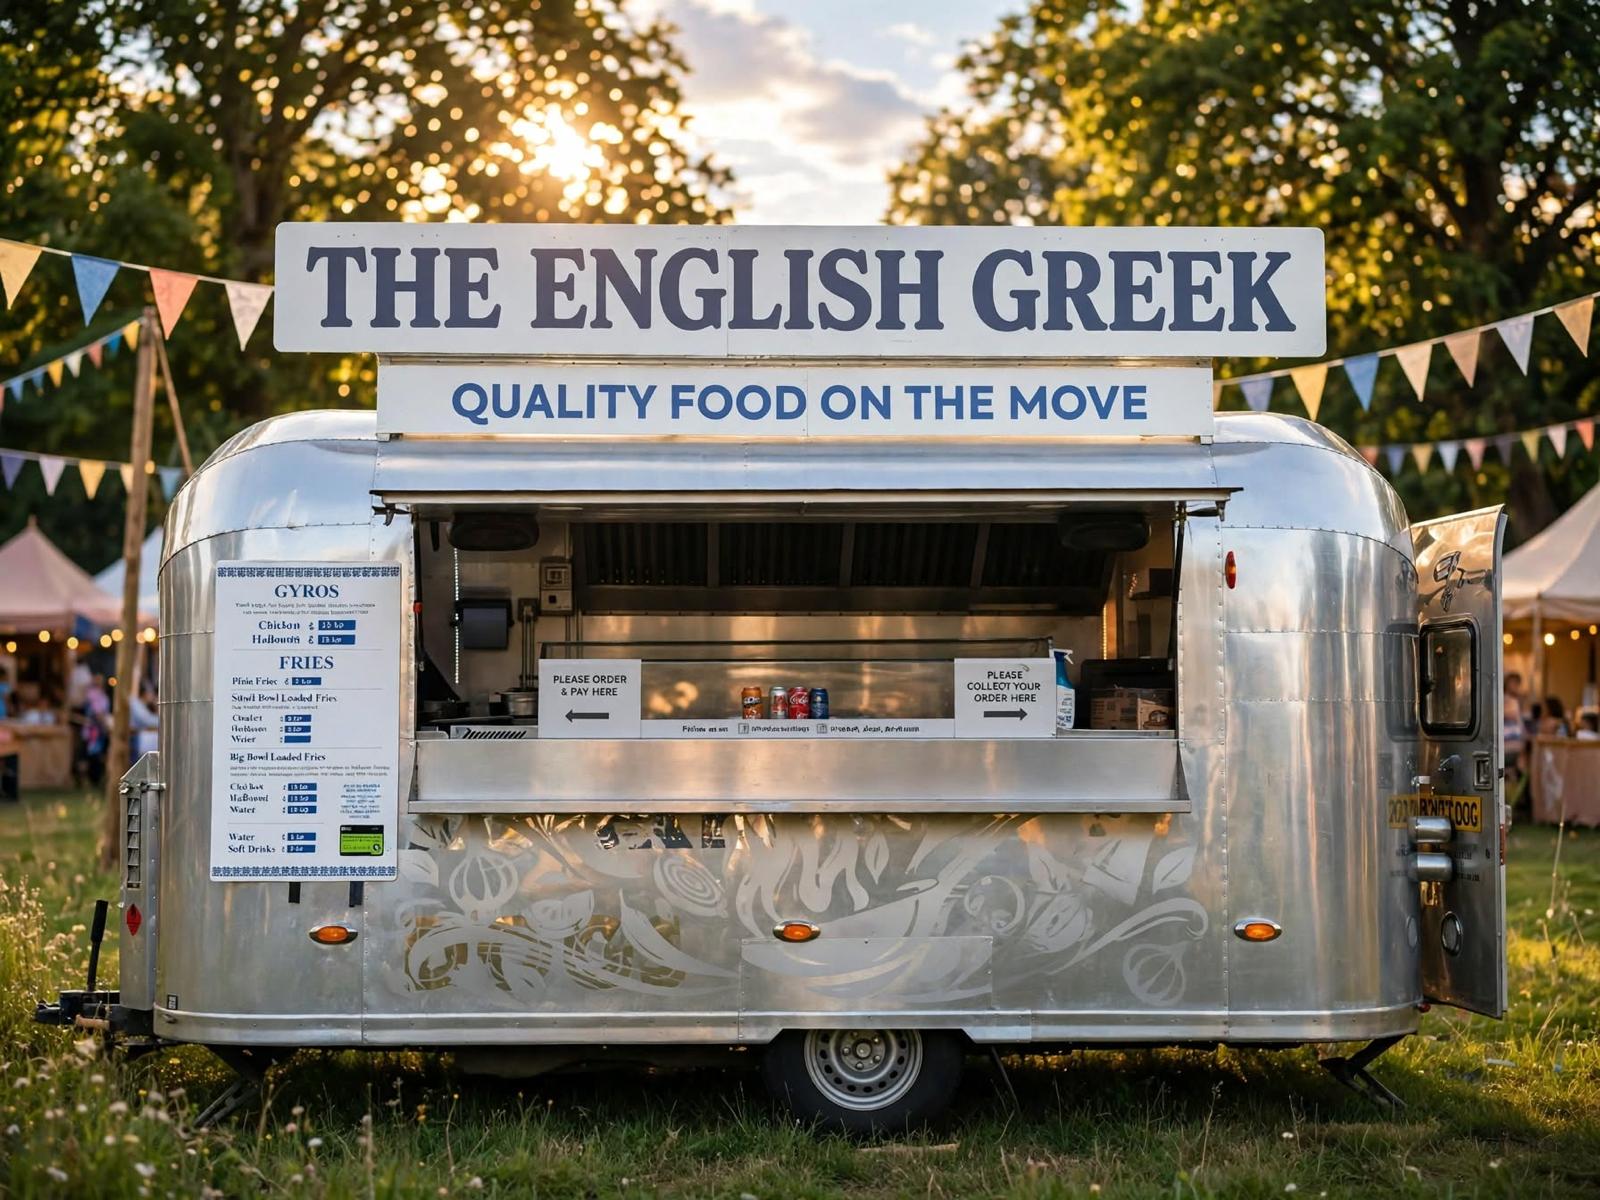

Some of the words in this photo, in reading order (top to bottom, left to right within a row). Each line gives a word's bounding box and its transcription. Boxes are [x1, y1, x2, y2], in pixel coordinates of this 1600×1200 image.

[306, 246, 502, 329] THE
[530, 247, 945, 331] ENGLISH
[972, 248, 1297, 332] GREEK
[452, 382, 657, 425] QUALITY
[671, 384, 806, 420] FOOD
[820, 384, 891, 421] ON
[904, 385, 994, 420] THE
[1010, 384, 1148, 421] MOVE
[274, 584, 339, 599] GYROS
[279, 656, 334, 670] FRIES
[553, 674, 590, 684] PLEASE
[592, 674, 627, 684] ORDER
[987, 670, 1023, 680] PLEASE
[561, 687, 568, 696] &
[570, 687, 589, 696] PAY
[592, 687, 618, 696] HERE
[967, 682, 1011, 691] COLLECT
[1013, 682, 1041, 691] YOUR
[281, 693, 313, 703] Loaded
[974, 693, 1008, 703] ORDER
[1011, 693, 1037, 703] HERE
[247, 752, 269, 761] Bowl
[270, 752, 304, 762] Loaded
[228, 832, 255, 841] Water
[228, 845, 246, 853] Soft
